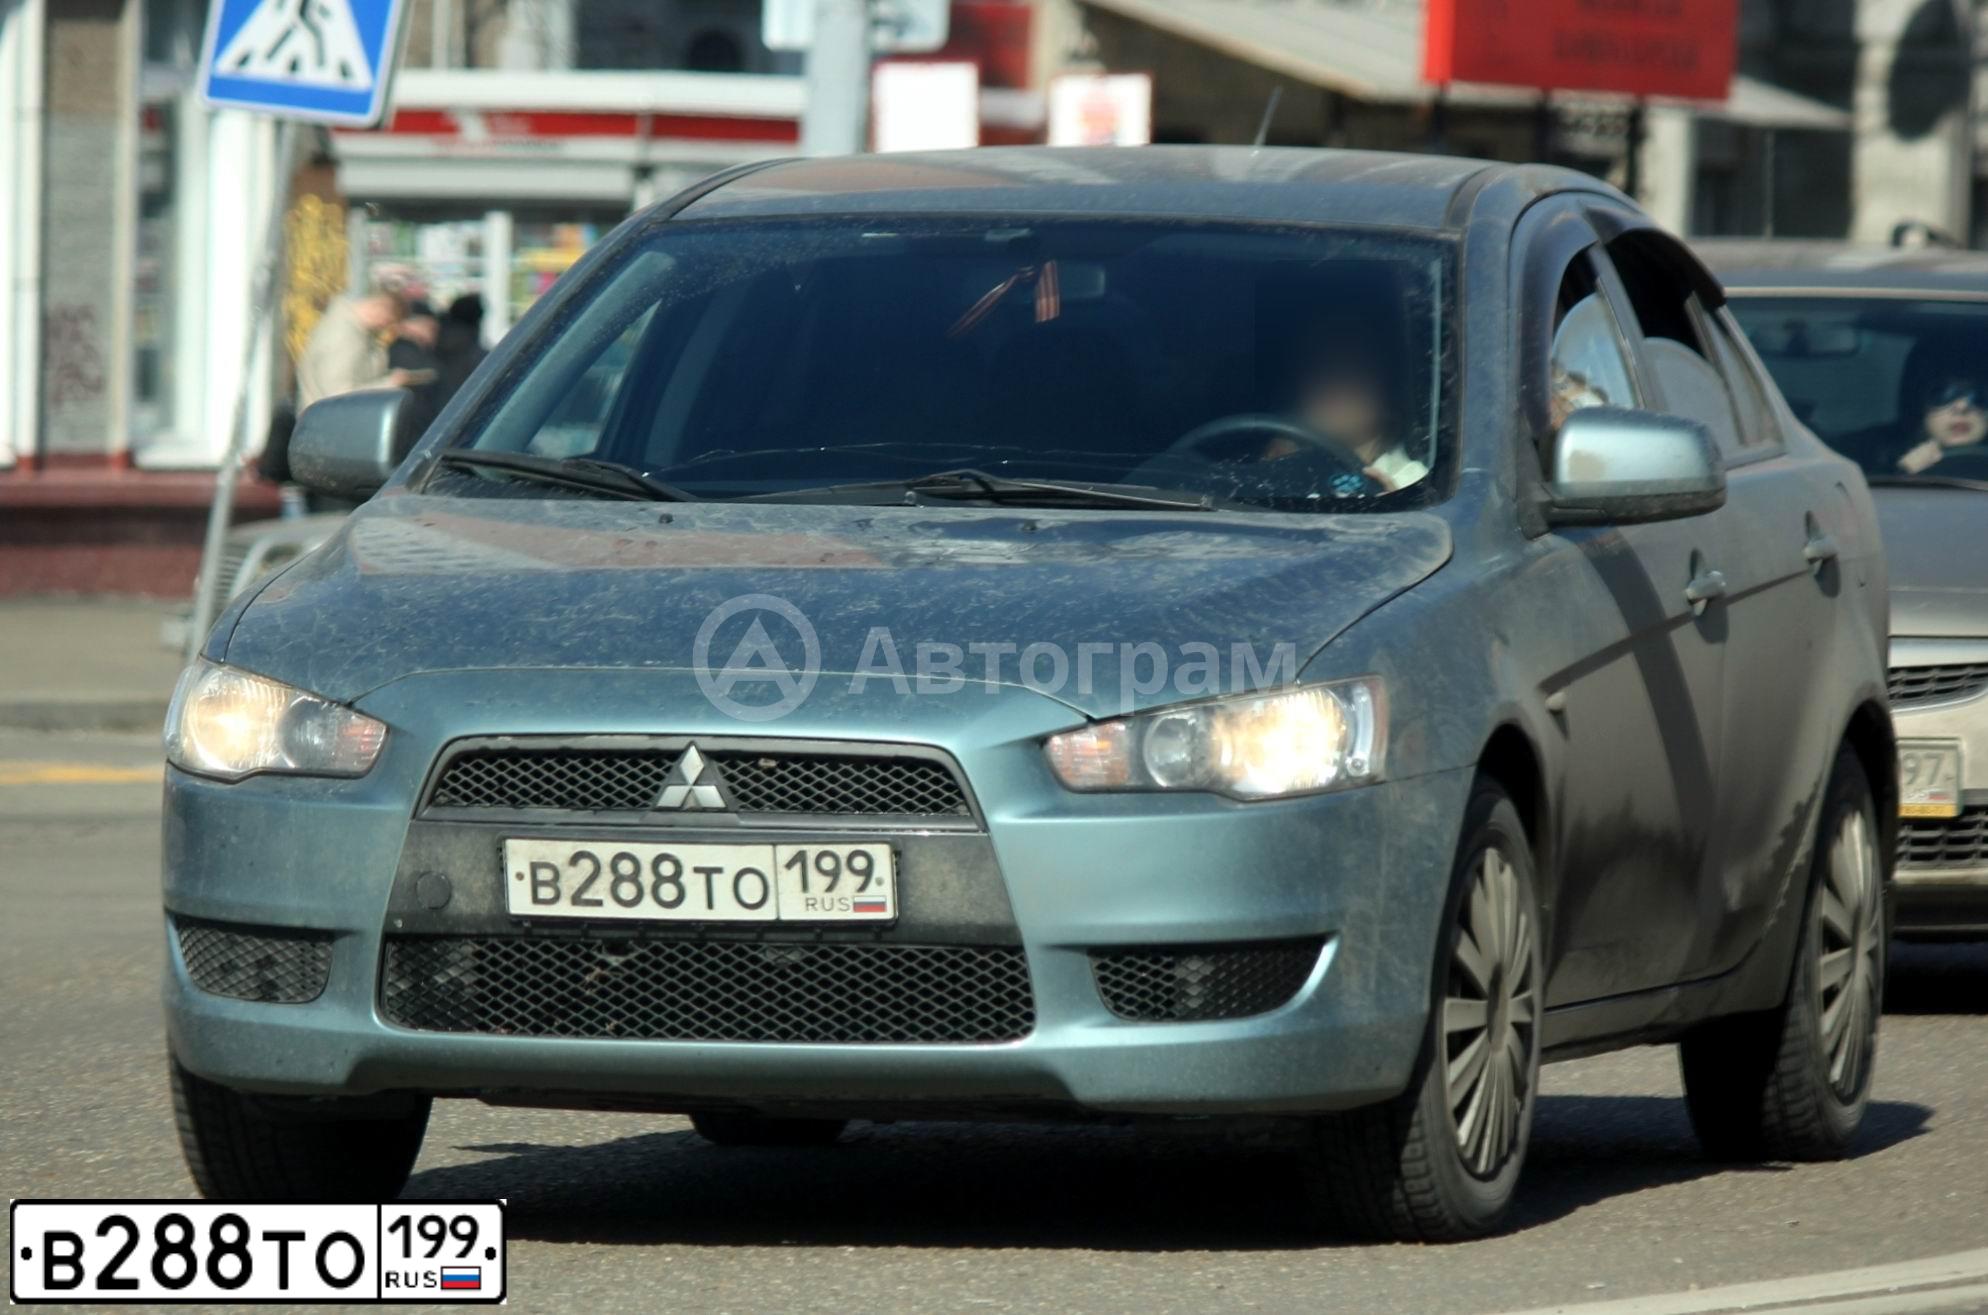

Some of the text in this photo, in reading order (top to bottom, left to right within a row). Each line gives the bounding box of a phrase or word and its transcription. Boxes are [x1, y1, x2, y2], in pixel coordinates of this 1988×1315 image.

[529, 849, 875, 910] В288ТО 199
[804, 896, 852, 912] RUS
